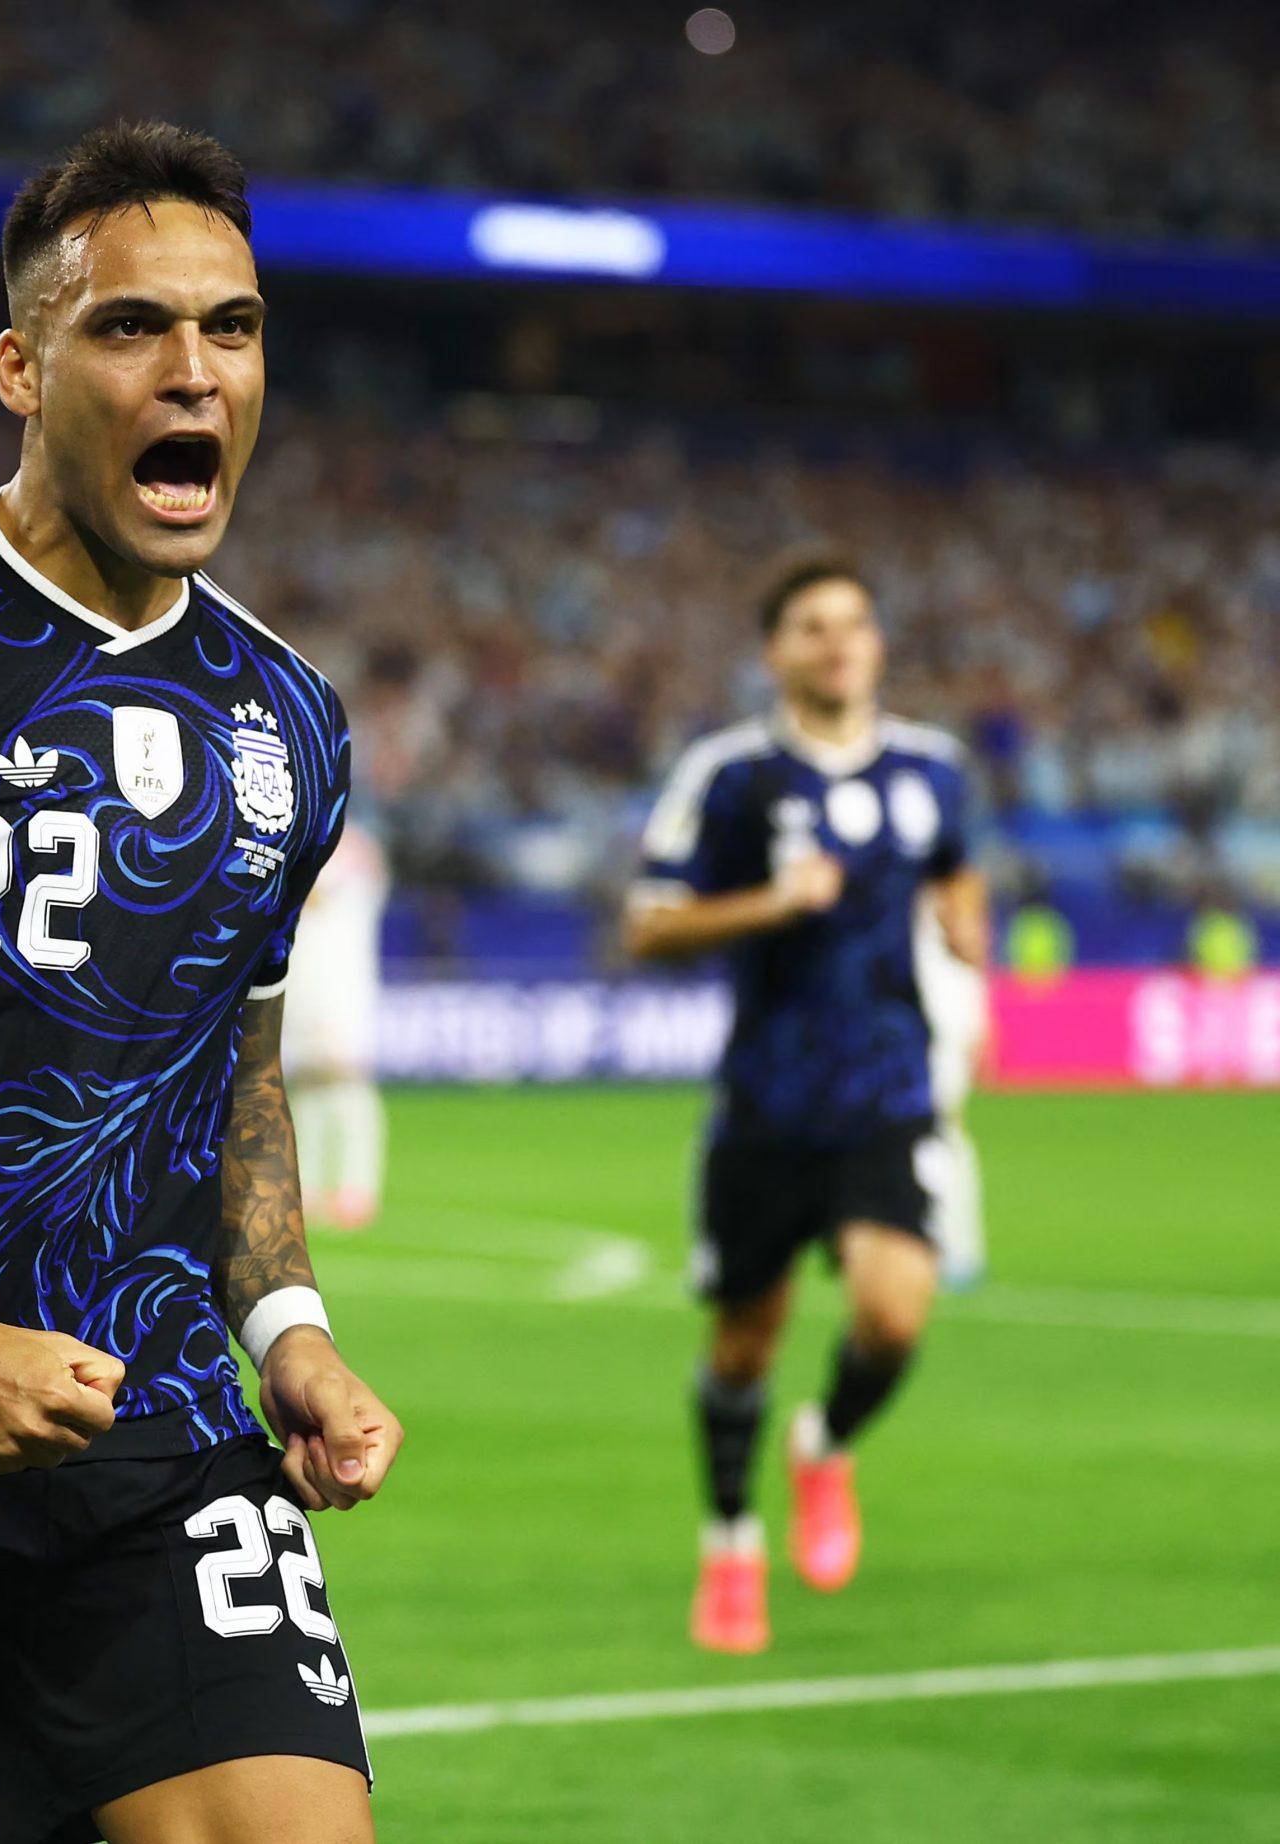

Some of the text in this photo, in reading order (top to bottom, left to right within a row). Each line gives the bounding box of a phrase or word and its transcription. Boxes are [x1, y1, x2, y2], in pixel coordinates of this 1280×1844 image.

[135, 775, 164, 790] FIFA
[250, 757, 282, 803] AFA
[184, 1494, 337, 1645] 22
